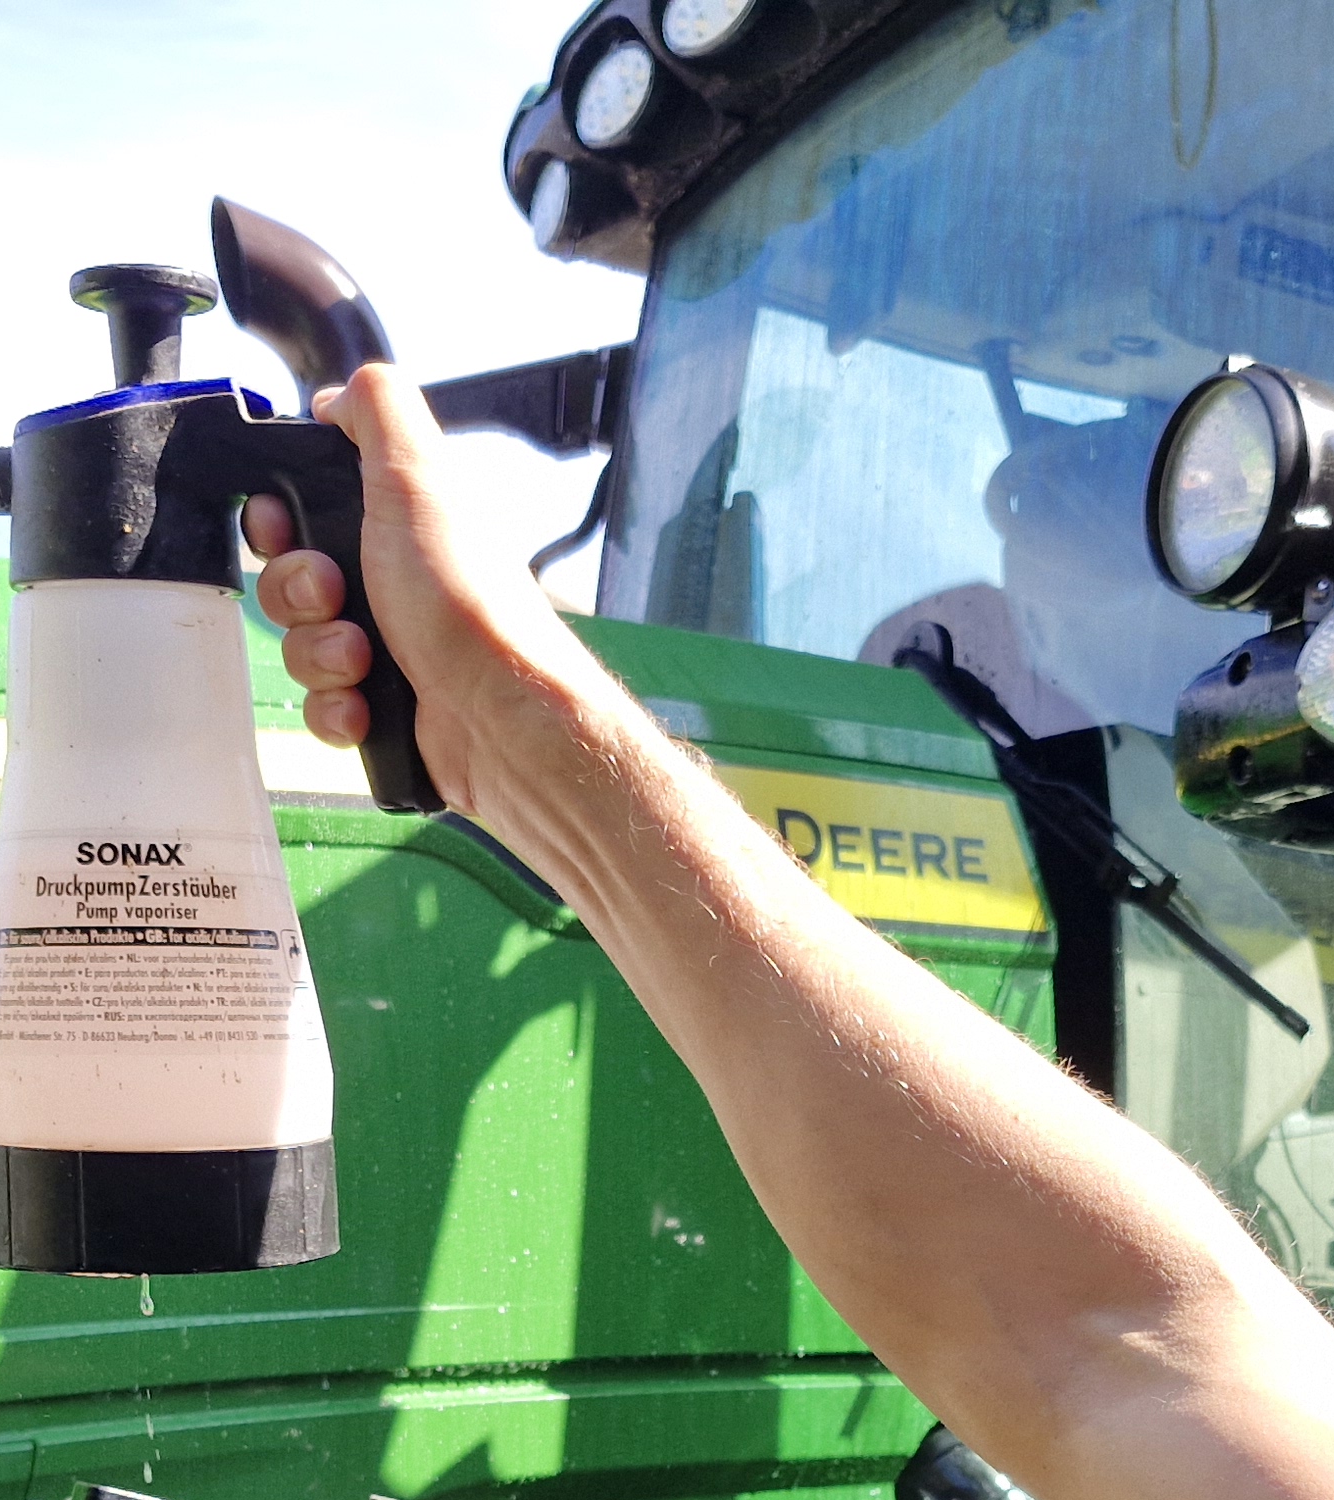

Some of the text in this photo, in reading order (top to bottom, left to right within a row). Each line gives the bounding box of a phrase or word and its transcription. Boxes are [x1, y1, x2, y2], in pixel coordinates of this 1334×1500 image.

[76, 841, 185, 866] SONAX
[776, 808, 988, 884] DEERE
[36, 874, 237, 901] DruckpumpZerstäuber
[76, 902, 199, 923] Pump vaporiser
[90, 929, 135, 943] Produkte
[169, 929, 184, 943] for
